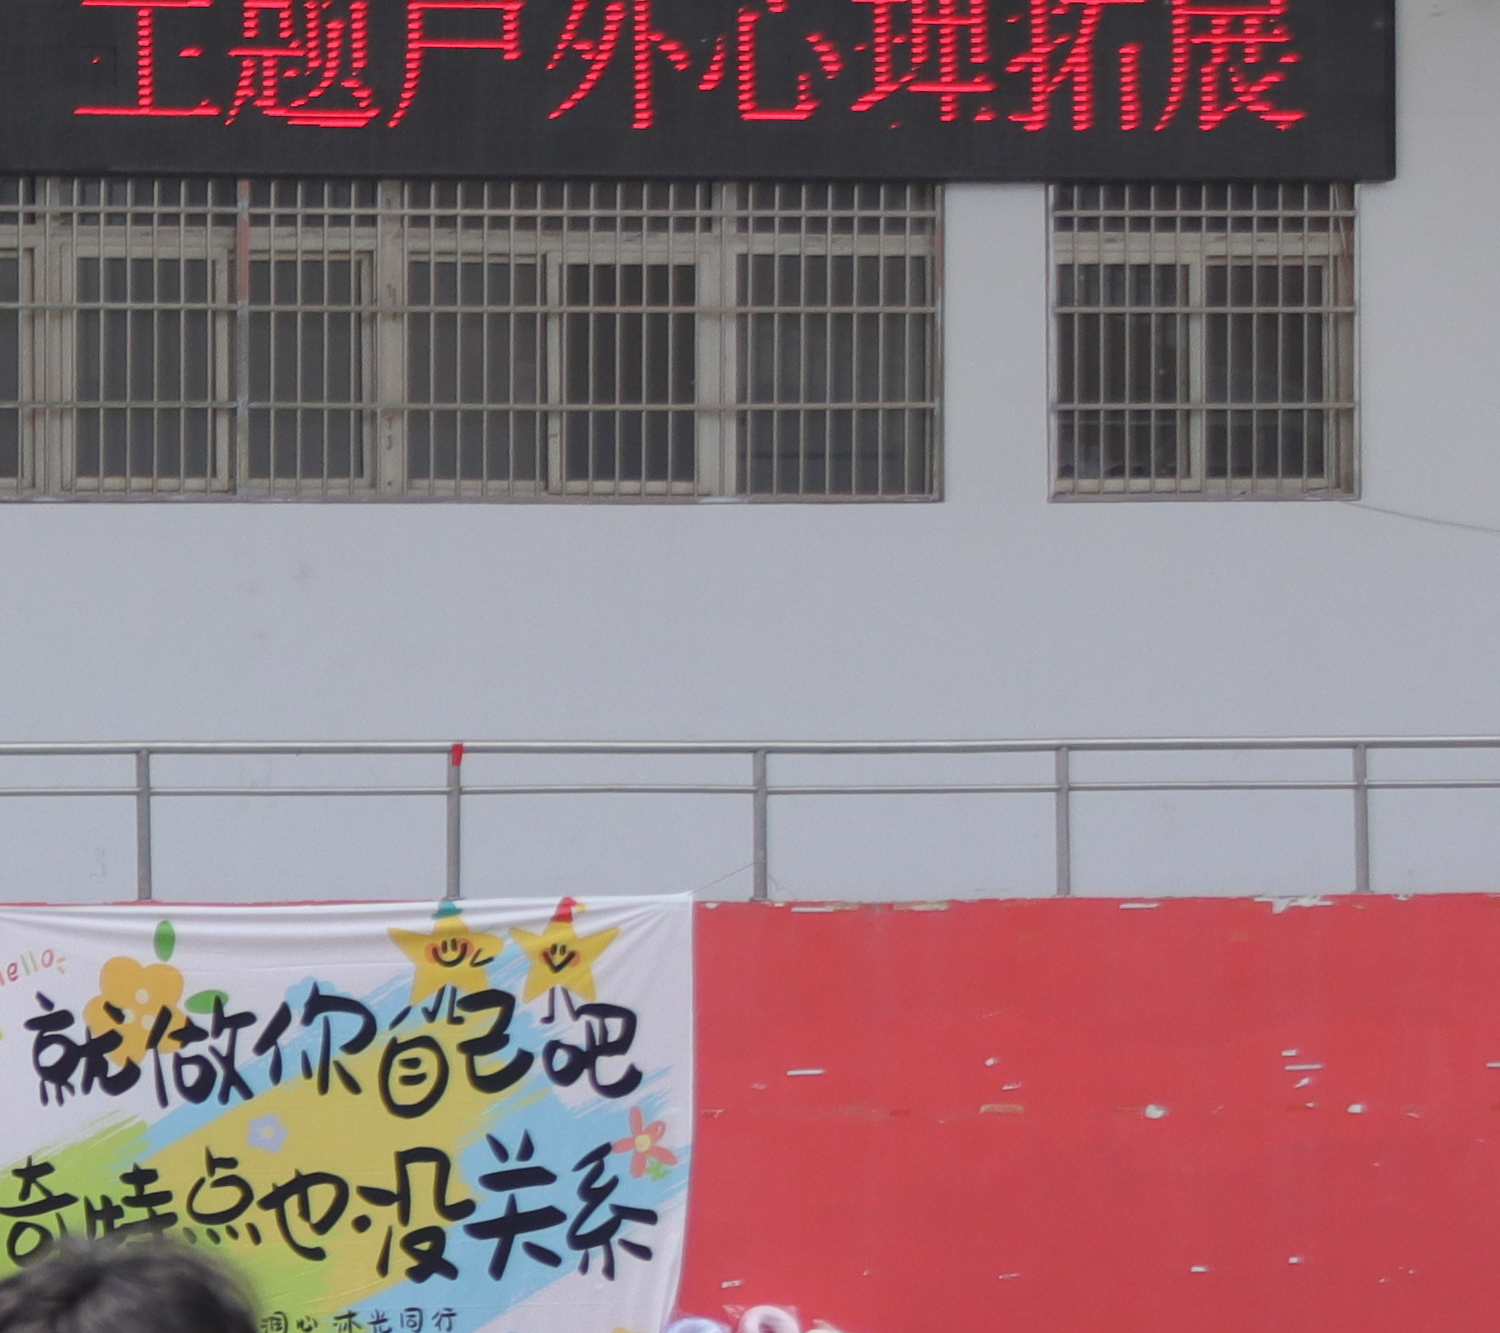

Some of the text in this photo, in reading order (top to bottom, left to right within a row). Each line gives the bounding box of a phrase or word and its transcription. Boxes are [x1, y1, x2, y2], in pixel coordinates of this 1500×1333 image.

[24, 981, 643, 1119] 就做你自己吧
